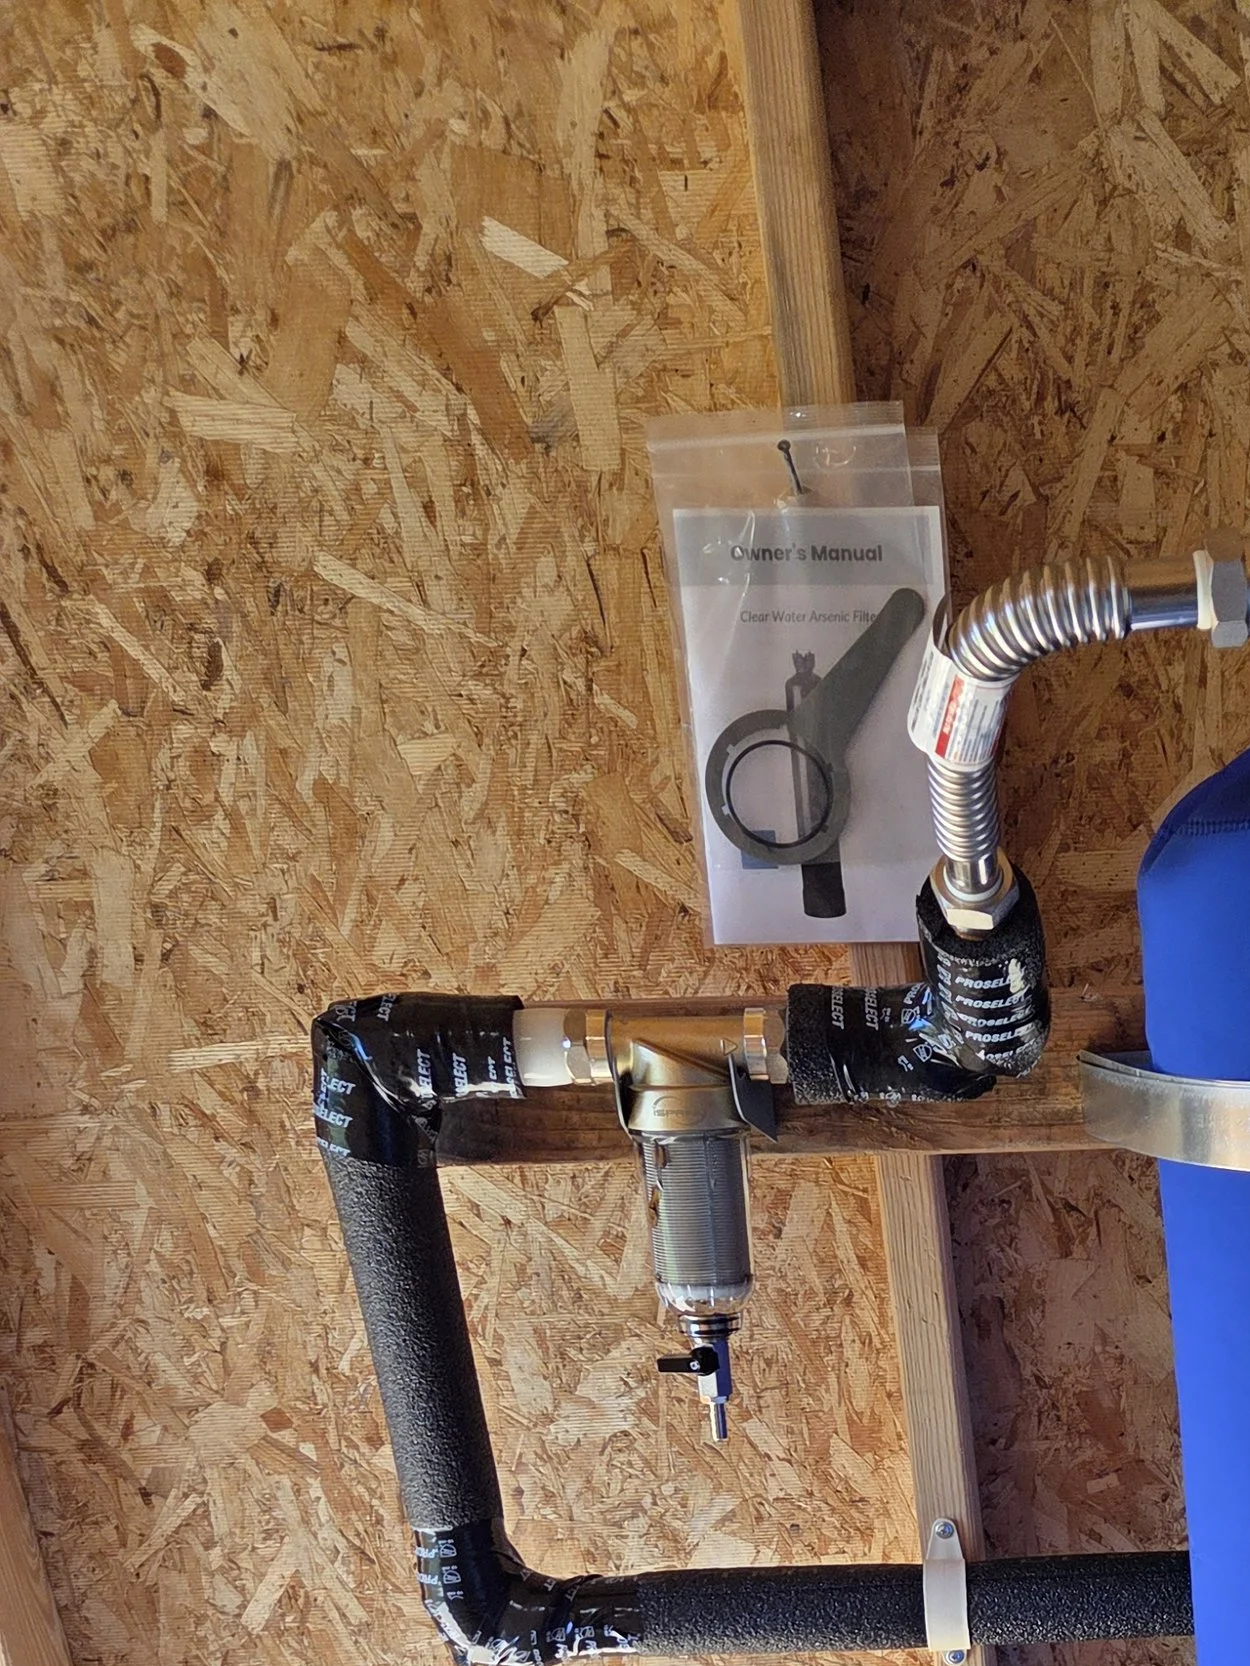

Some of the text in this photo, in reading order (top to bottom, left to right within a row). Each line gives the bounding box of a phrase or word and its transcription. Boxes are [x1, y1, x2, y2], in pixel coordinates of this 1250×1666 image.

[730, 543, 883, 562] Owner's Manual
[740, 609, 878, 624] Clear Water Arsenic Filte
